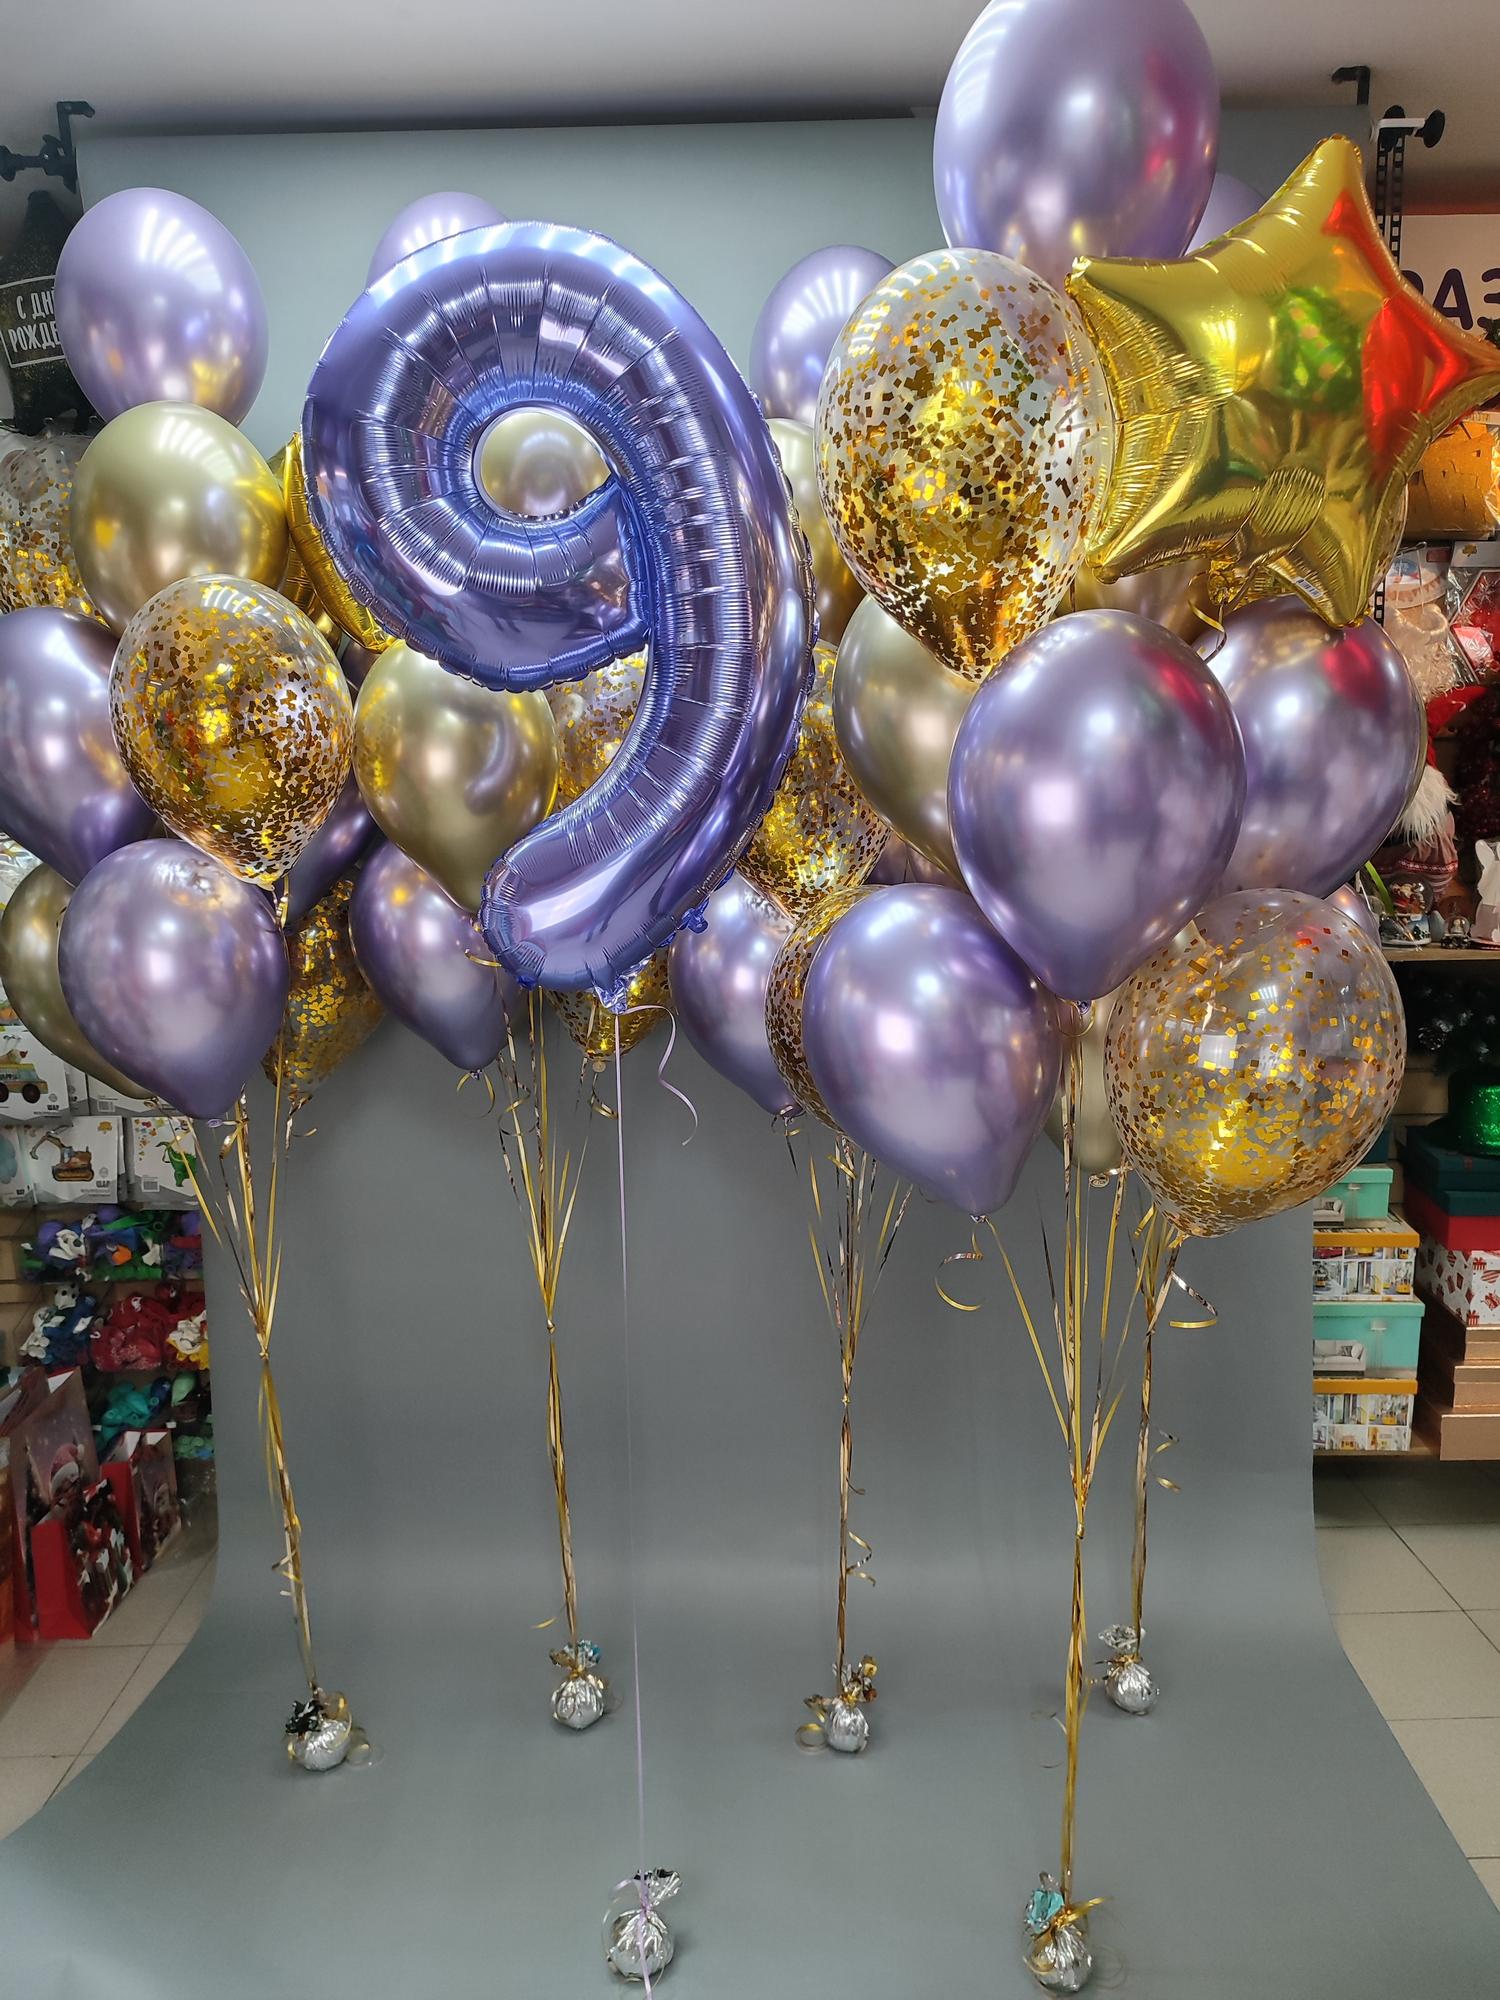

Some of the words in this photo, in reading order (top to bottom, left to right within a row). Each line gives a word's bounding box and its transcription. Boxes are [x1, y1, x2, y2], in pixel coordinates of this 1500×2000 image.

[16, 295, 26, 319] С
[1401, 268, 1500, 330] АЗ
[302, 221, 818, 992] 9
